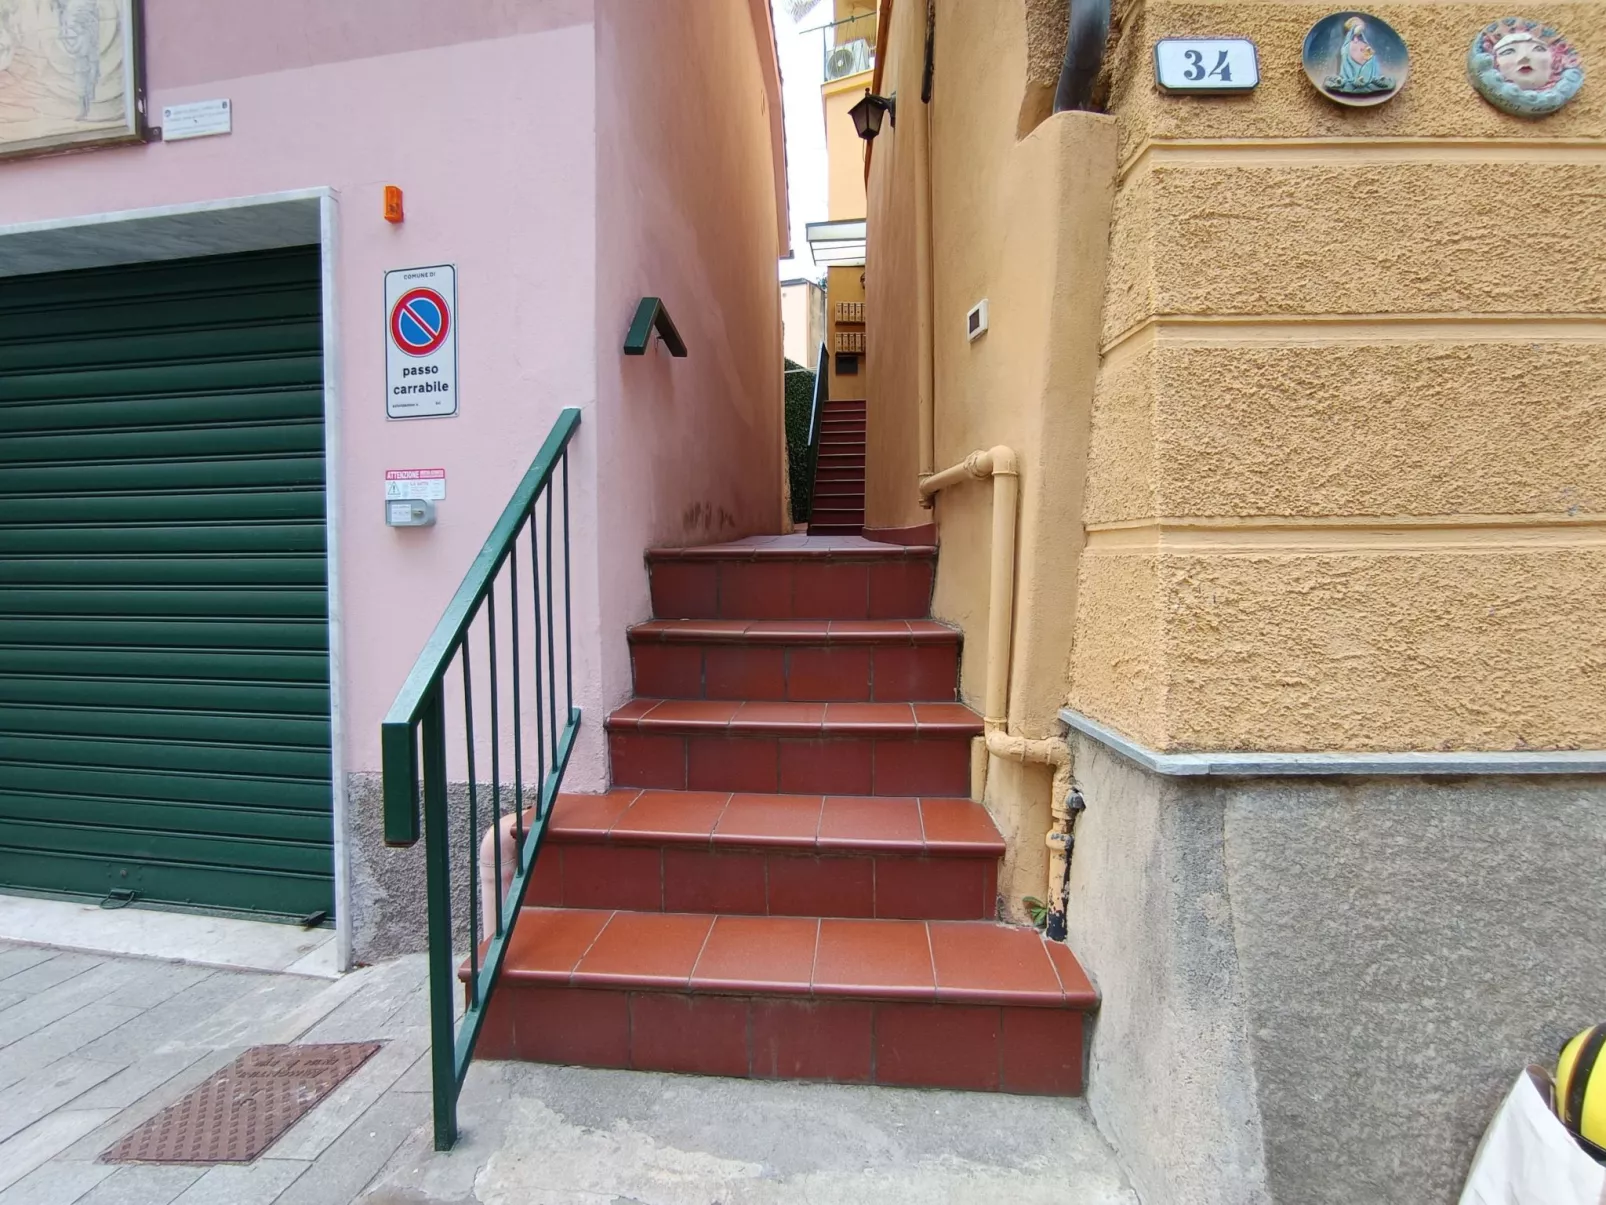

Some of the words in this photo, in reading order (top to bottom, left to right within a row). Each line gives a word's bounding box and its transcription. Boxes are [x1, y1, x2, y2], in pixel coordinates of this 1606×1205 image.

[1183, 49, 1233, 82] 34
[403, 272, 429, 280] COMUNE
[403, 365, 439, 379] passo
[393, 381, 449, 395] carrabile
